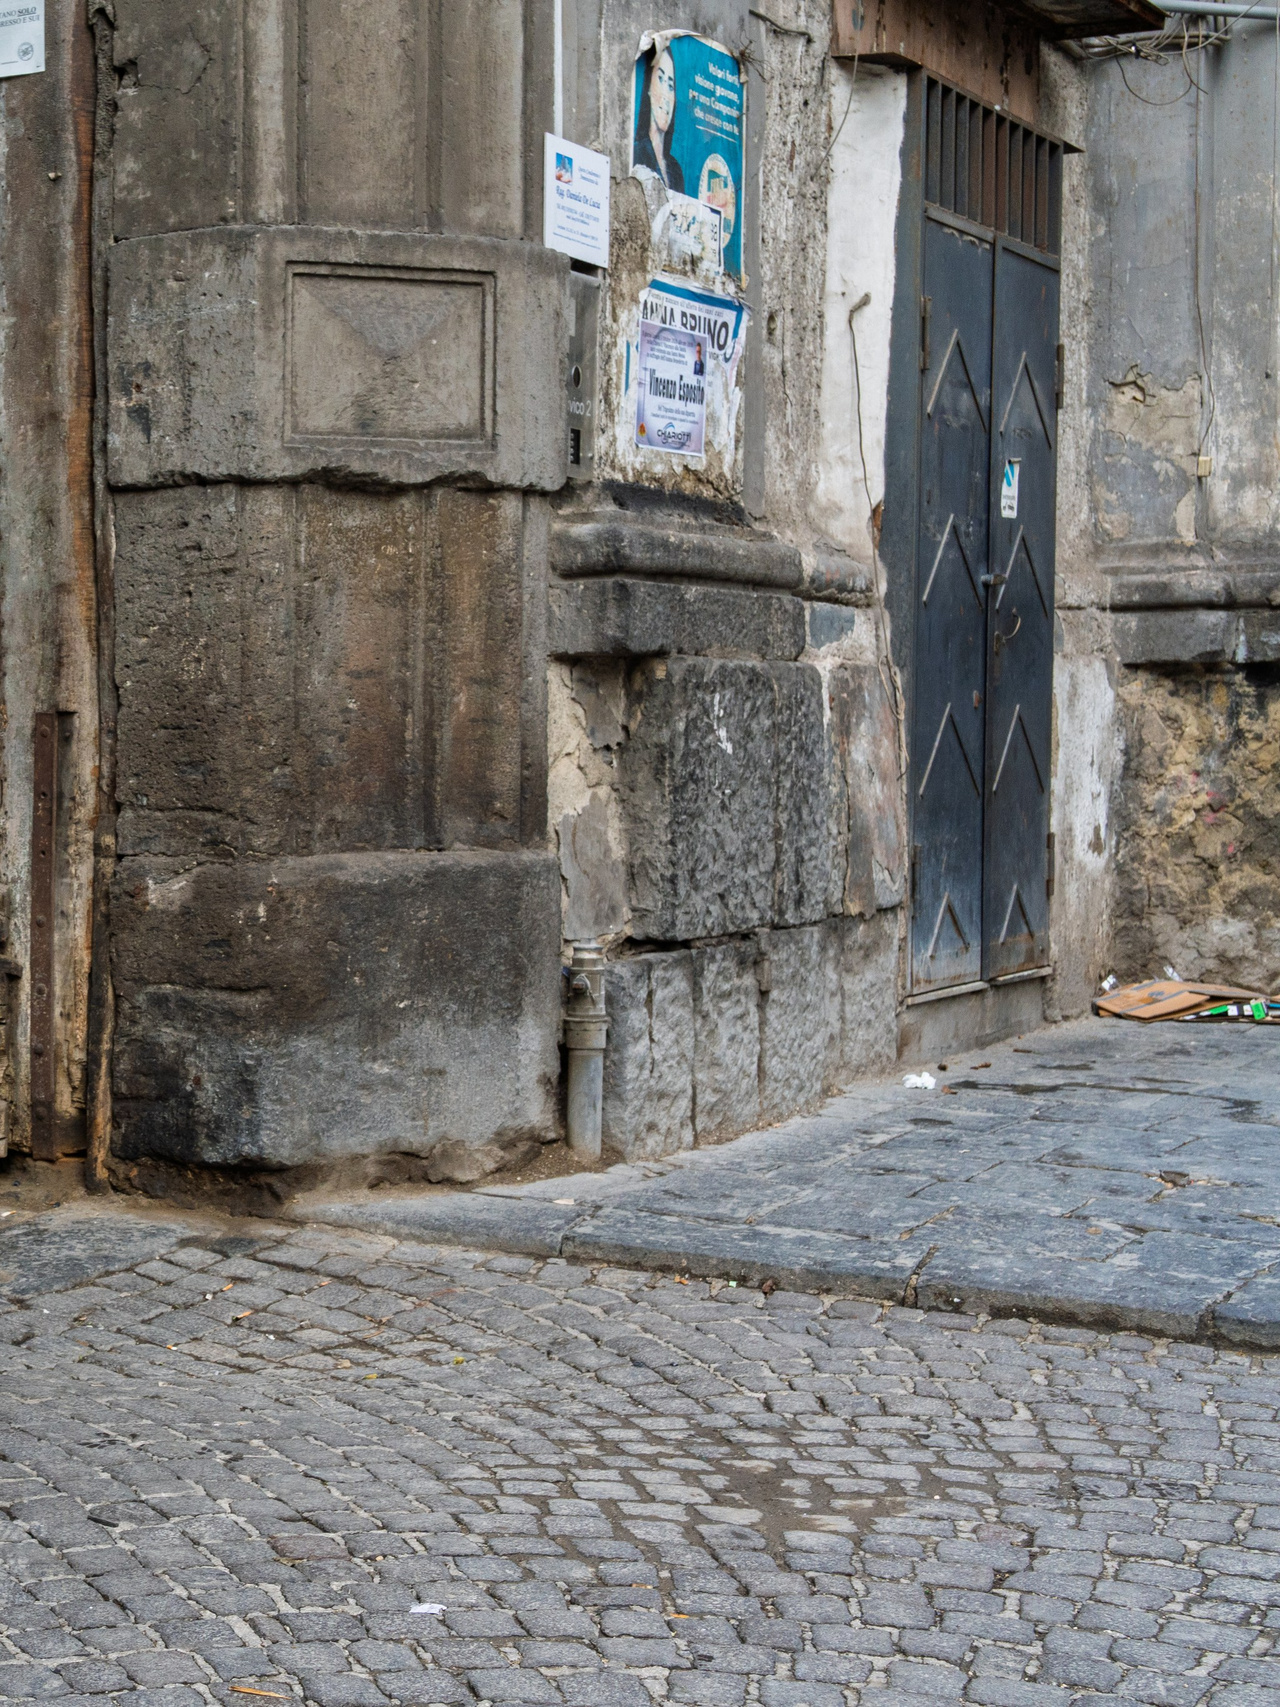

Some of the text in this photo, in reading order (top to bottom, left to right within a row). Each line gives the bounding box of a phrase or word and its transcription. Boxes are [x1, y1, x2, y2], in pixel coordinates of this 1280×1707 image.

[17, 6, 37, 17] SOLO
[708, 61, 726, 80] Valori
[694, 73, 740, 105] visione giovane,
[699, 93, 710, 106] una
[694, 106, 705, 120] che
[705, 113, 722, 128] cresce
[722, 121, 733, 133] con
[642, 299, 675, 326] ANNA
[680, 310, 729, 351] BRUNO
[649, 368, 677, 400] Vincenzo
[678, 374, 705, 408] Esposito
[586, 400, 592, 417] 2
[656, 429, 692, 442] CHIARIOTTI
